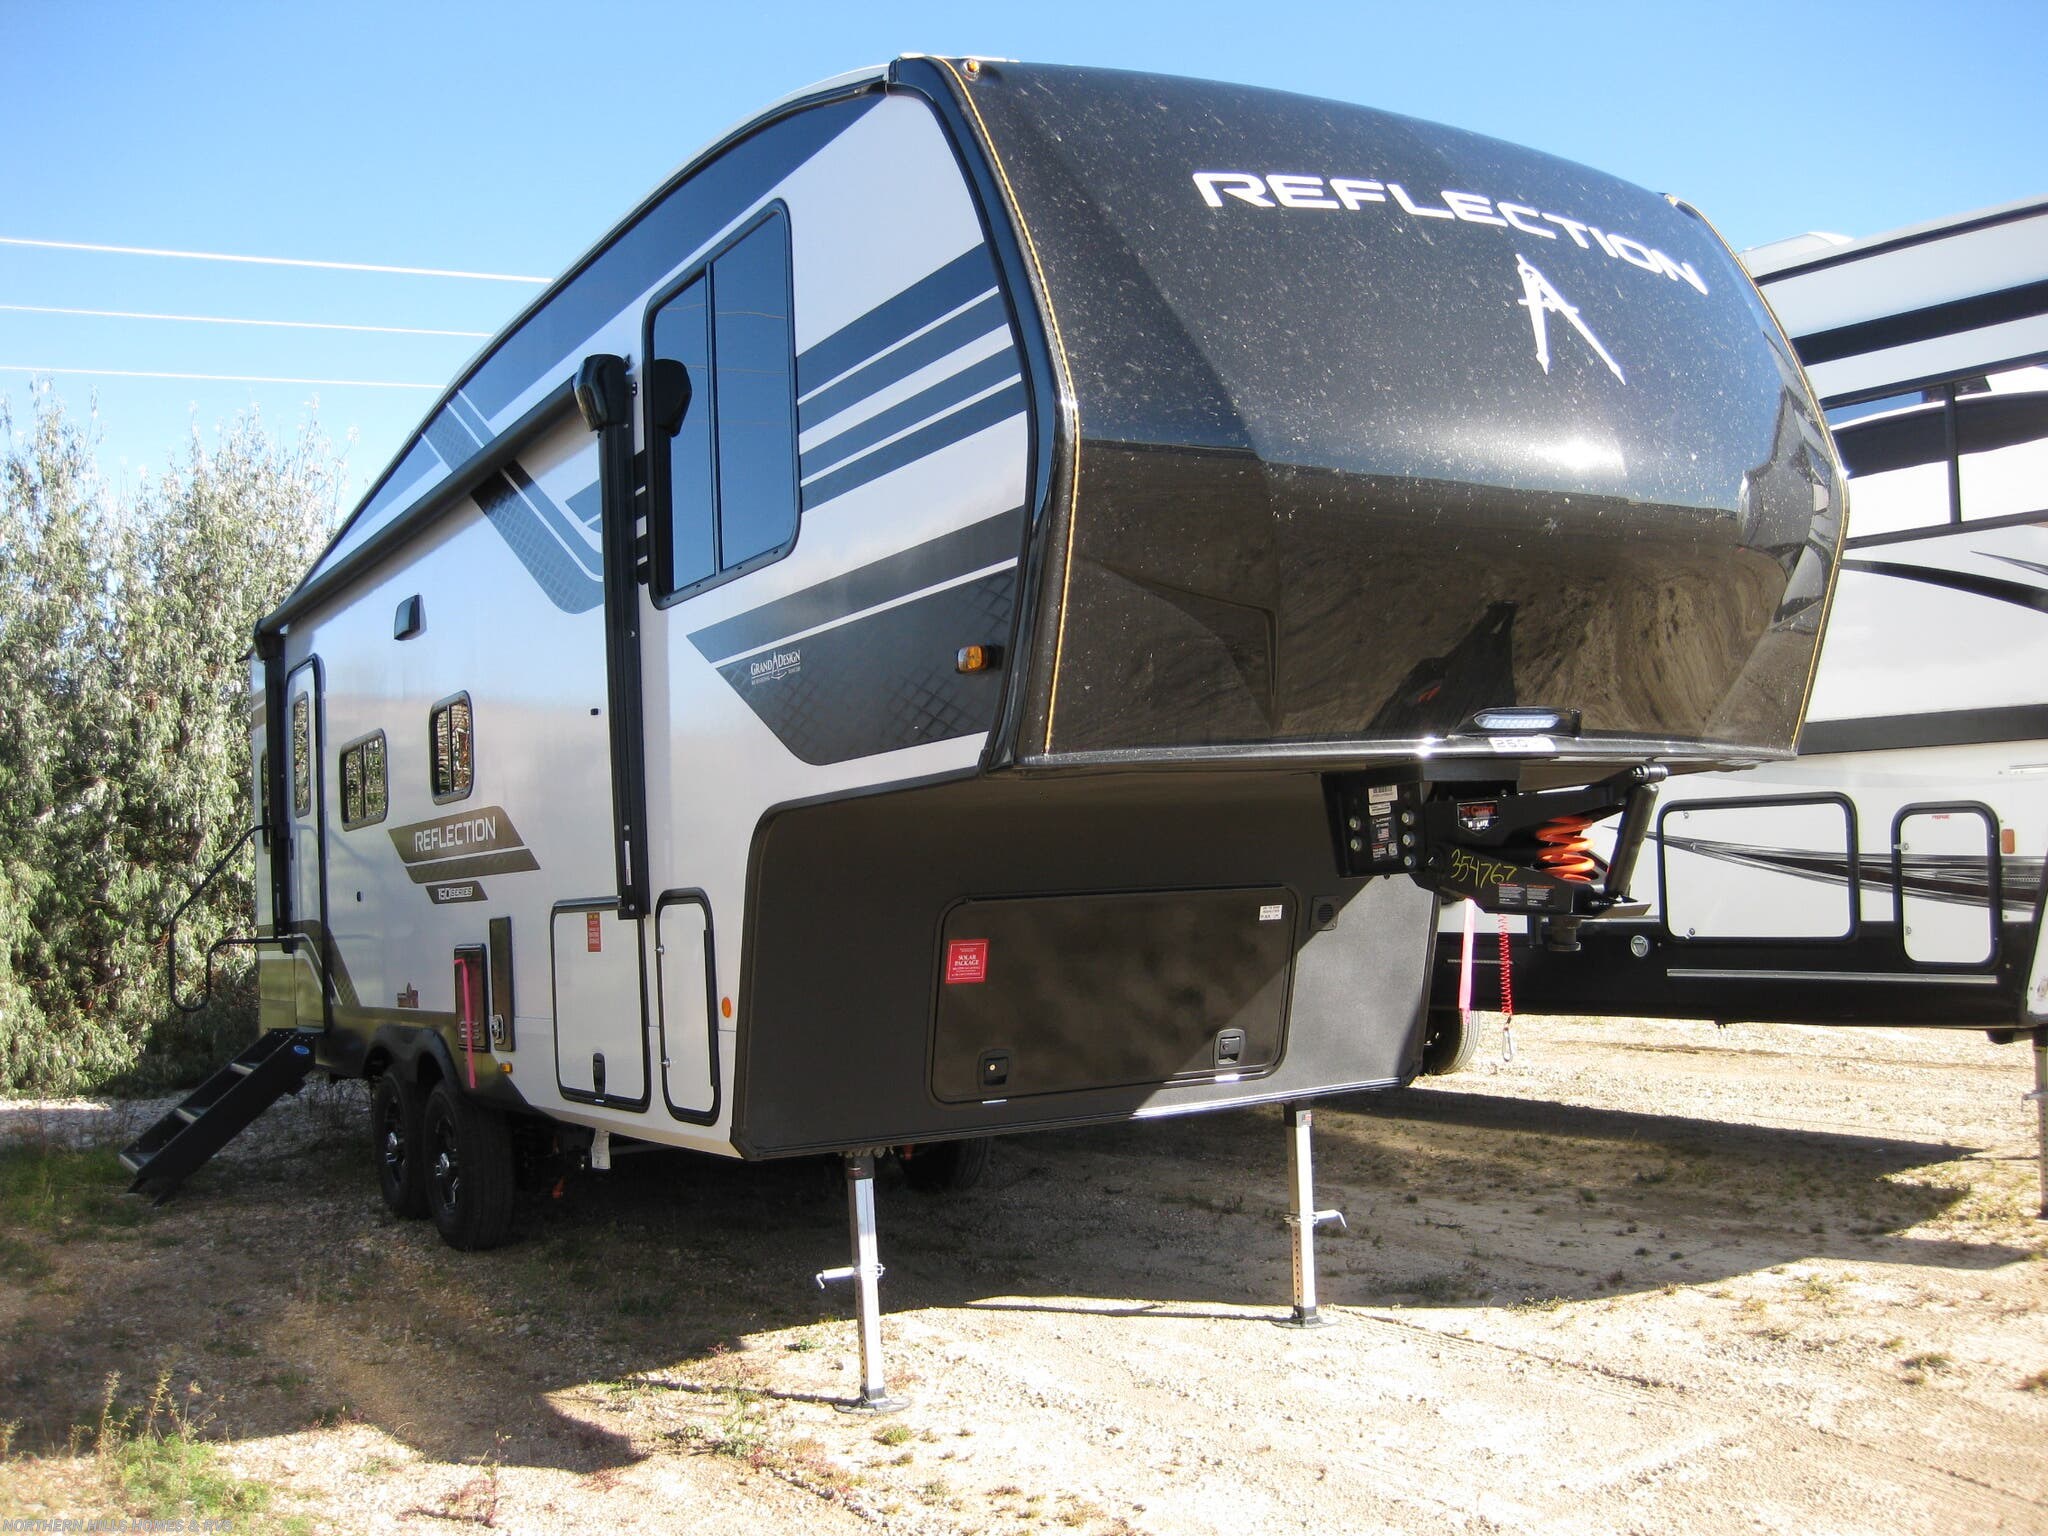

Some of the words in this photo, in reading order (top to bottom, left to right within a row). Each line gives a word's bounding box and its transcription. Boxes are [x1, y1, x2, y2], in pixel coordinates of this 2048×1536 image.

[1192, 172, 1709, 296] REFLECTION
[750, 659, 773, 676] GRAND
[777, 650, 801, 668] DESIGN
[415, 816, 496, 852] REFLECTION
[1450, 848, 1518, 889] 354767
